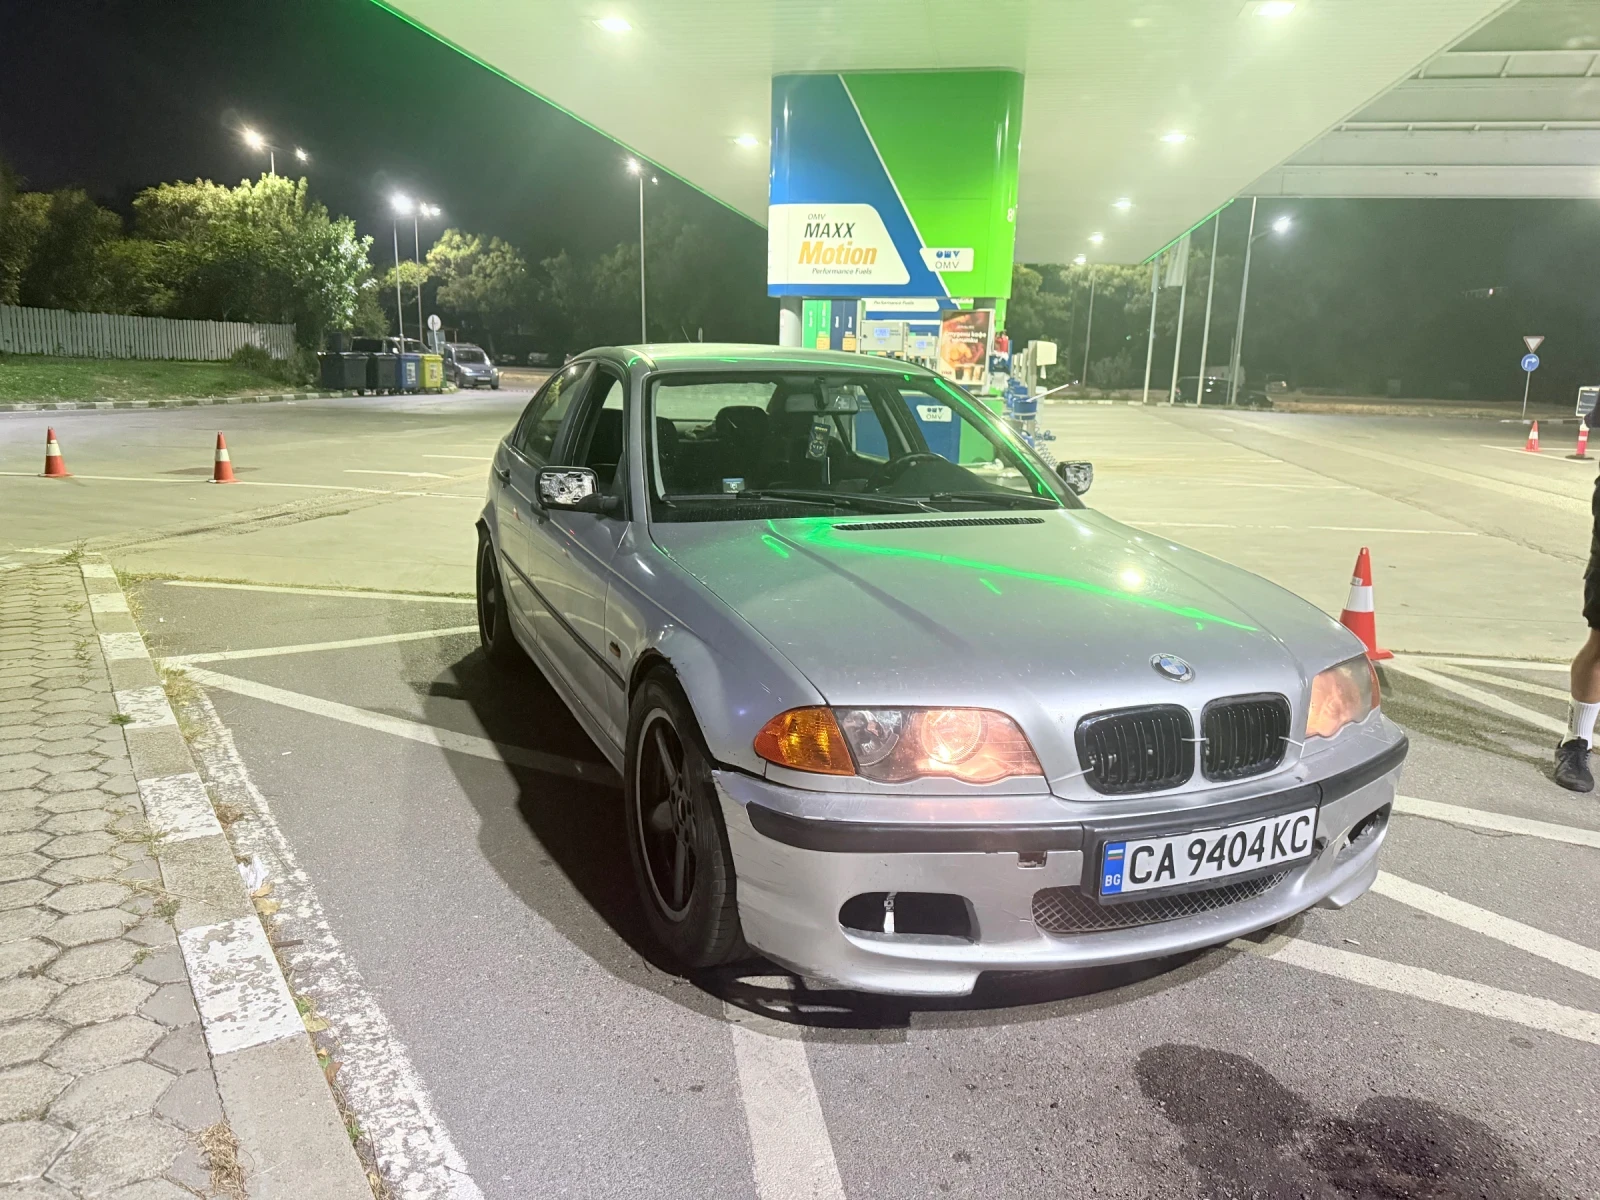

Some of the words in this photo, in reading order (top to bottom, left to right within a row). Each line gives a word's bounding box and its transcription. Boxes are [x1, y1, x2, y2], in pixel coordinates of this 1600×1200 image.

[804, 222, 856, 238] MAXX
[798, 241, 878, 265] Motion
[935, 261, 960, 269] OMV
[1129, 843, 1176, 884] CA
[1104, 873, 1121, 887] BG
